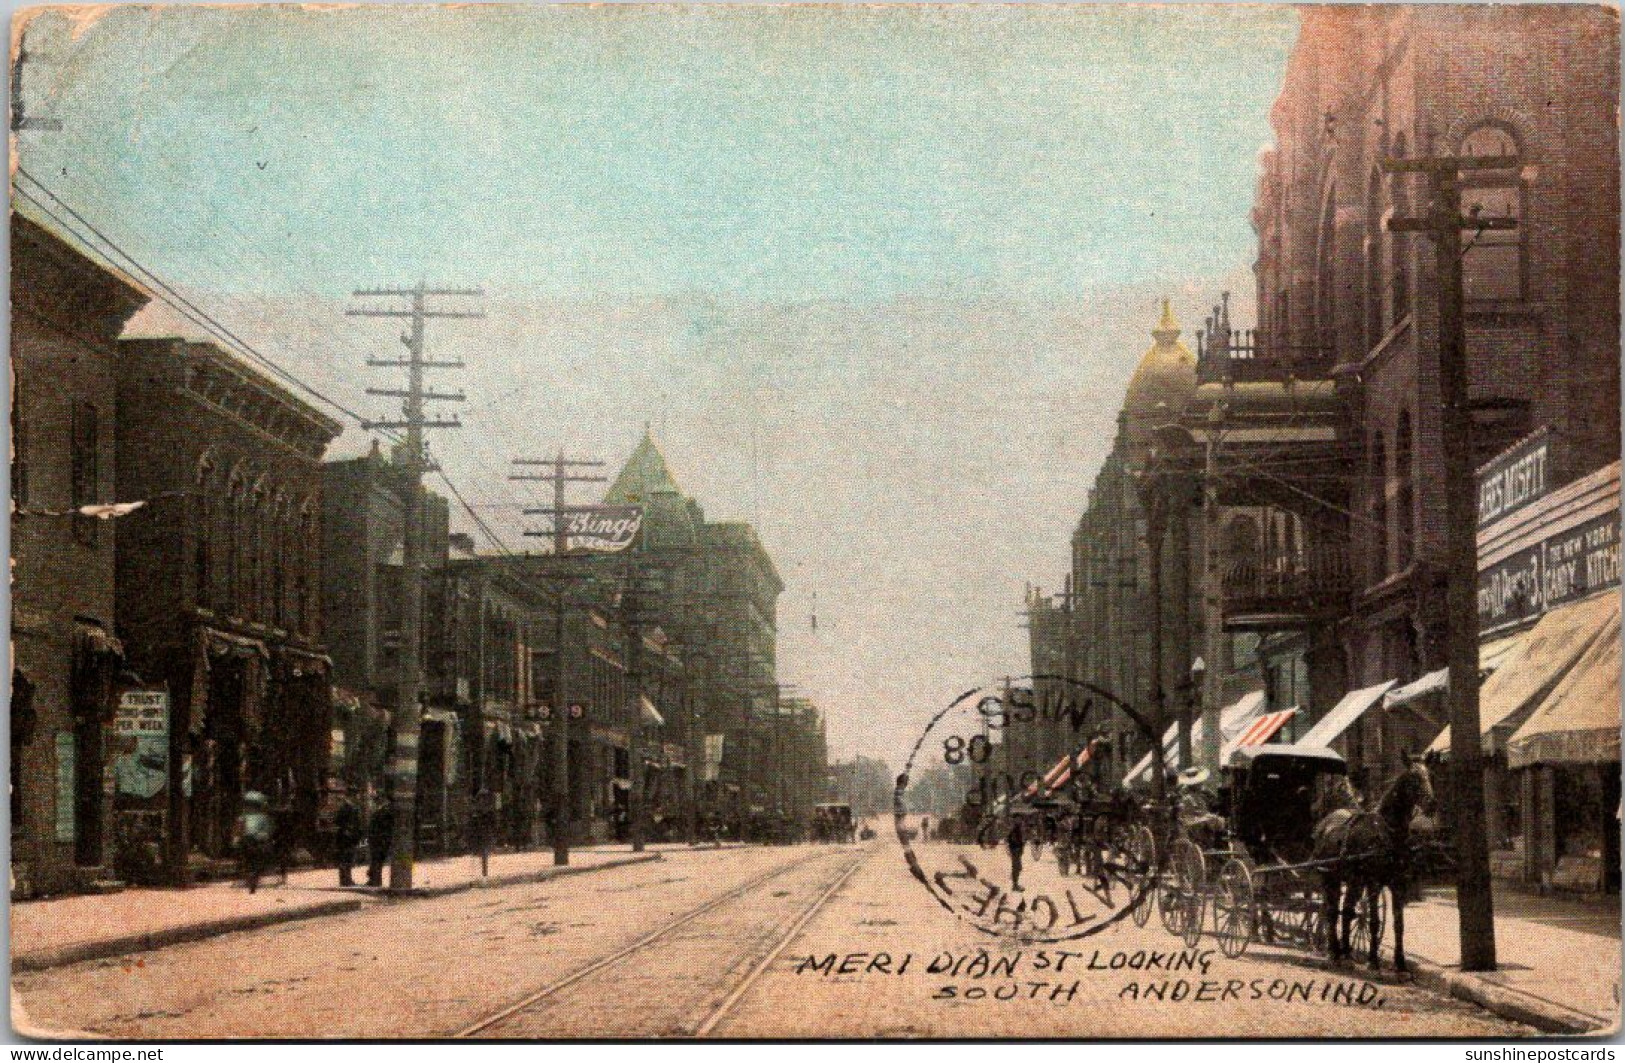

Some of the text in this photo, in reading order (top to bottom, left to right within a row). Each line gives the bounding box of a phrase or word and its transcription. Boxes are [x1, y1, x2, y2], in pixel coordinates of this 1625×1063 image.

[1503, 446, 1547, 512] MISFIT
[1563, 536, 1583, 557] NEW
[1585, 523, 1613, 548] YORK
